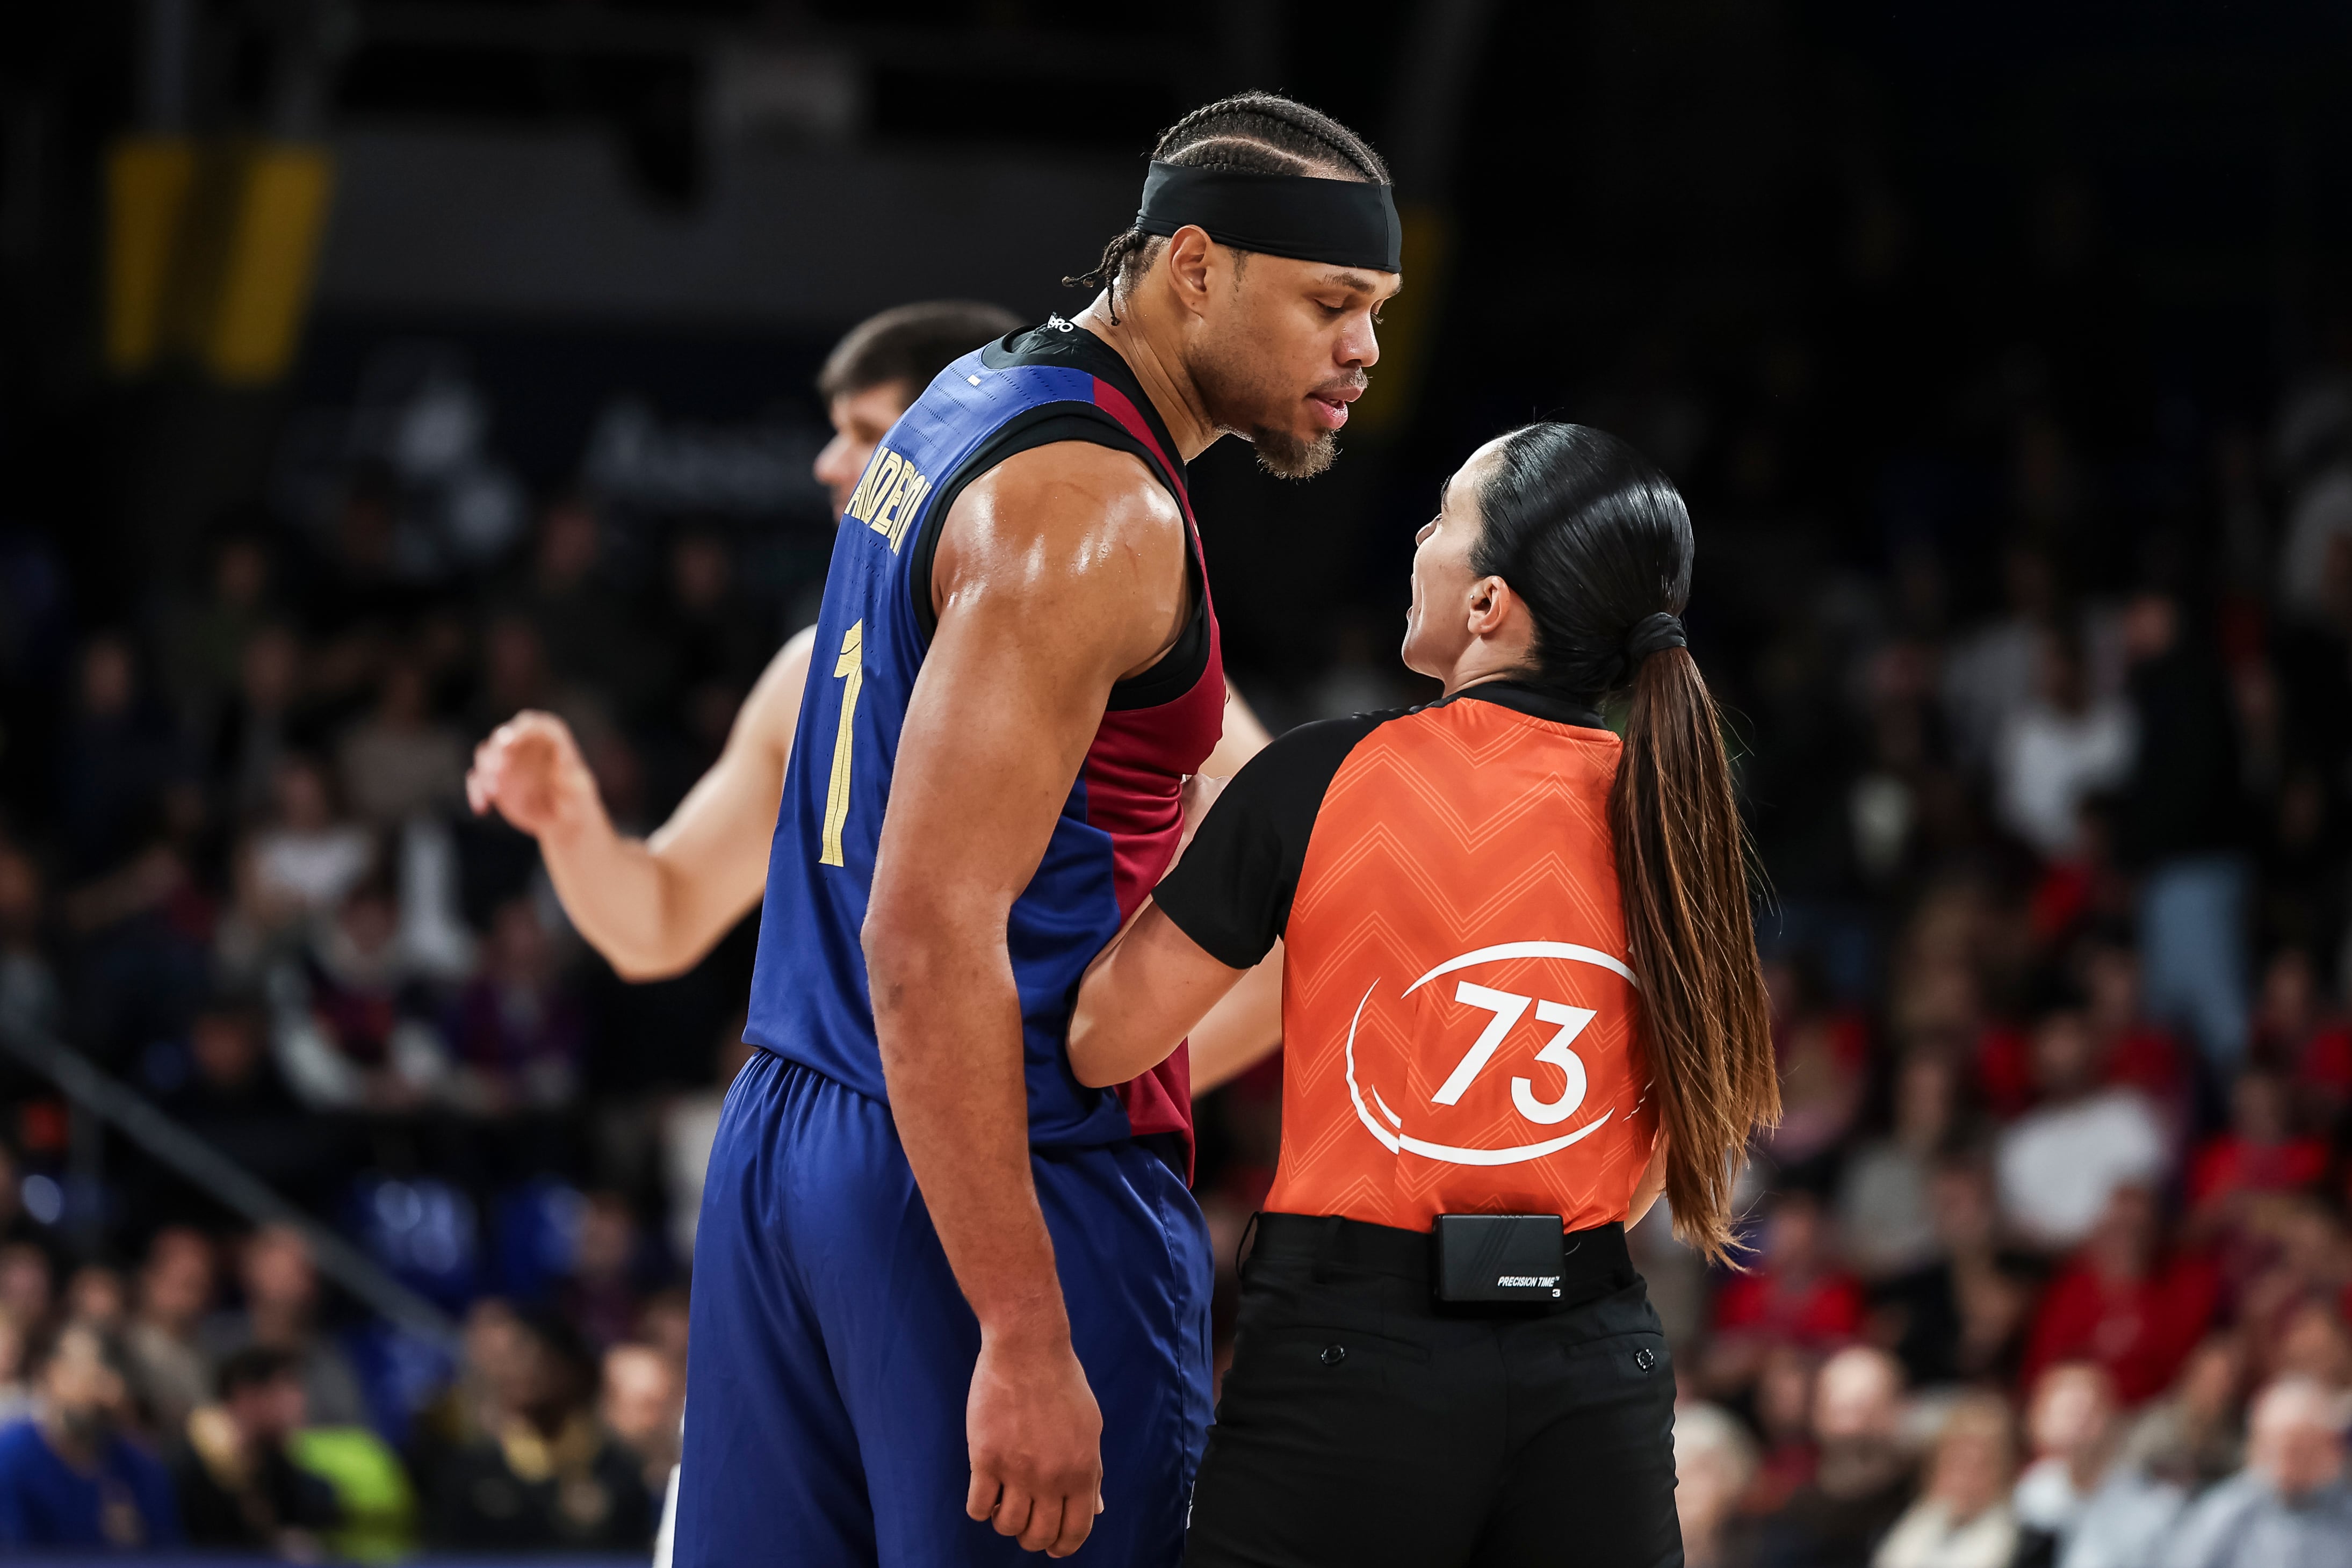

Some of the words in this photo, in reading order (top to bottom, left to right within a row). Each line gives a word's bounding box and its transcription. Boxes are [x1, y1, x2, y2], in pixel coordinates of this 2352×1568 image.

[818, 617, 863, 867] 1
[1431, 980, 1598, 1125] 73
[1497, 1276, 1538, 1287] PRECISION
[1552, 1289, 1561, 1297] 3
